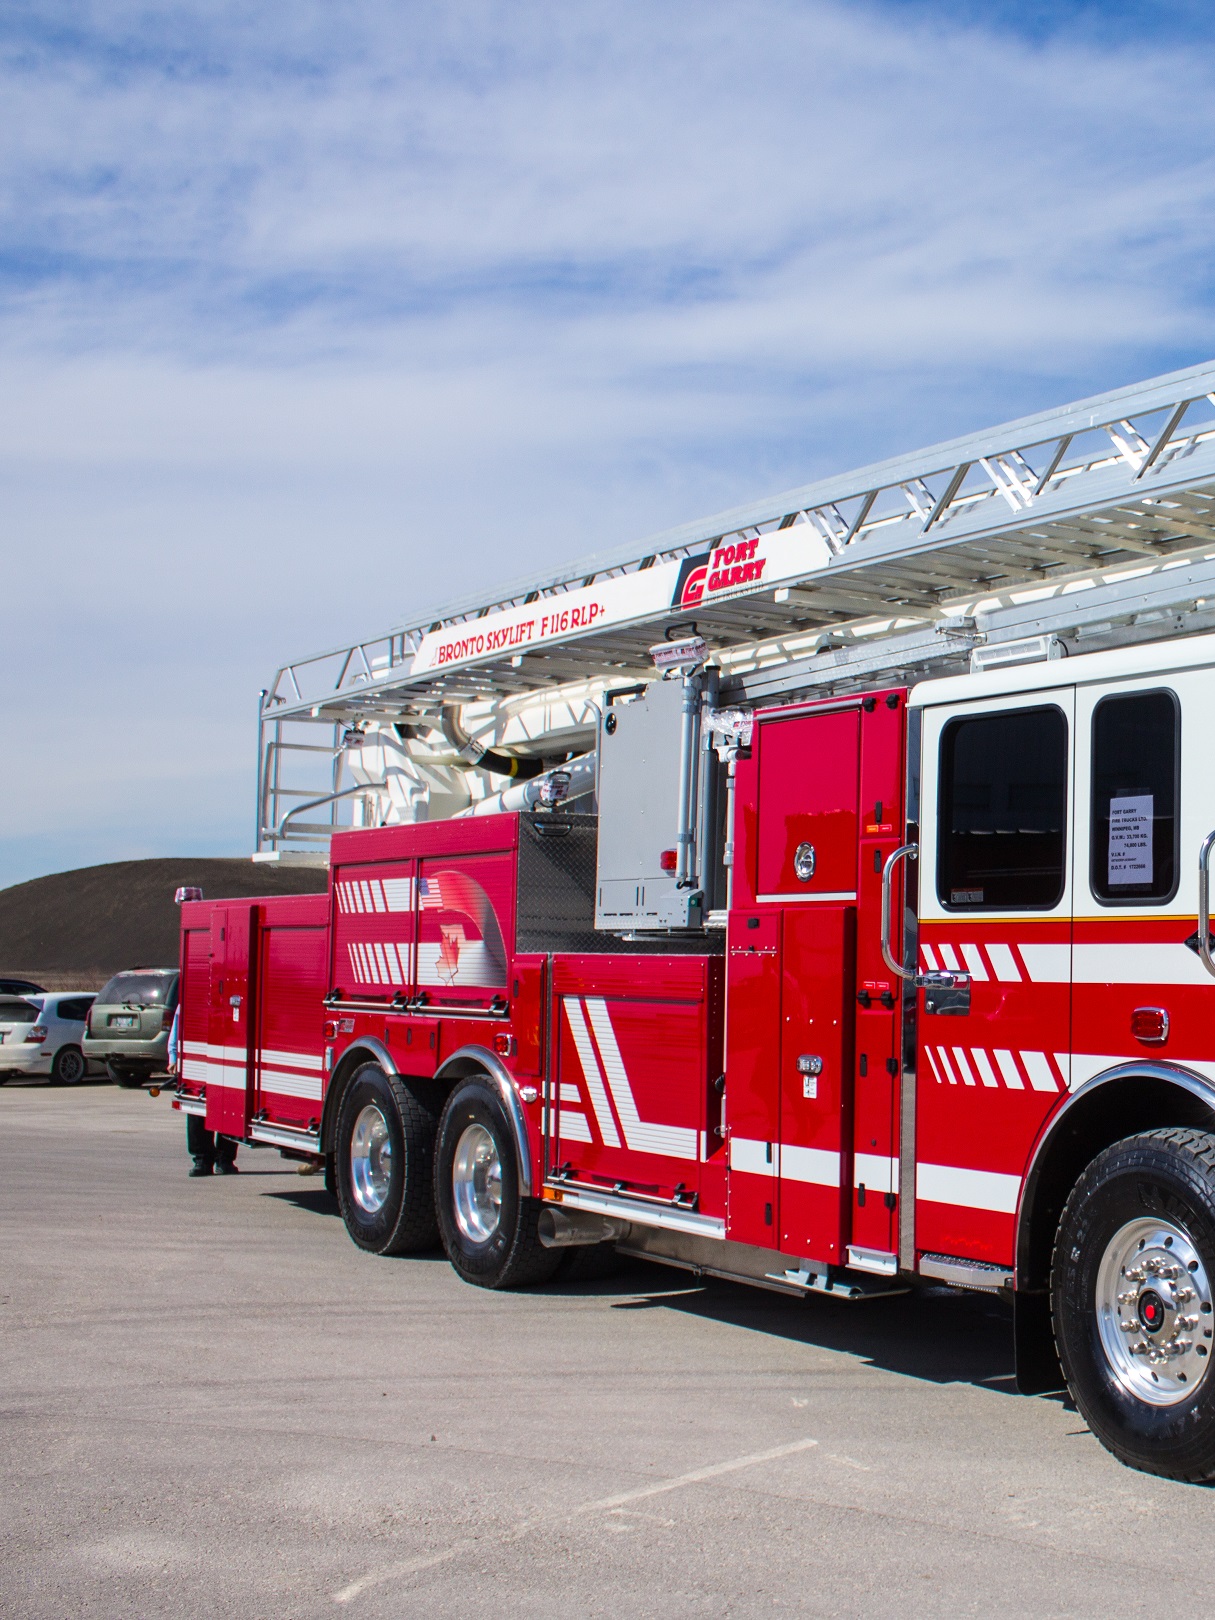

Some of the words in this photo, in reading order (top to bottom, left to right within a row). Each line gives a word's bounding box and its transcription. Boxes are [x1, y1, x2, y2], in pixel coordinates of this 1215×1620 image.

[712, 537, 759, 570] FORT
[707, 558, 767, 592] GARRY
[438, 635, 485, 665] BRONTO
[486, 620, 535, 650] SKYLIFT
[570, 602, 606, 629] RLP+
